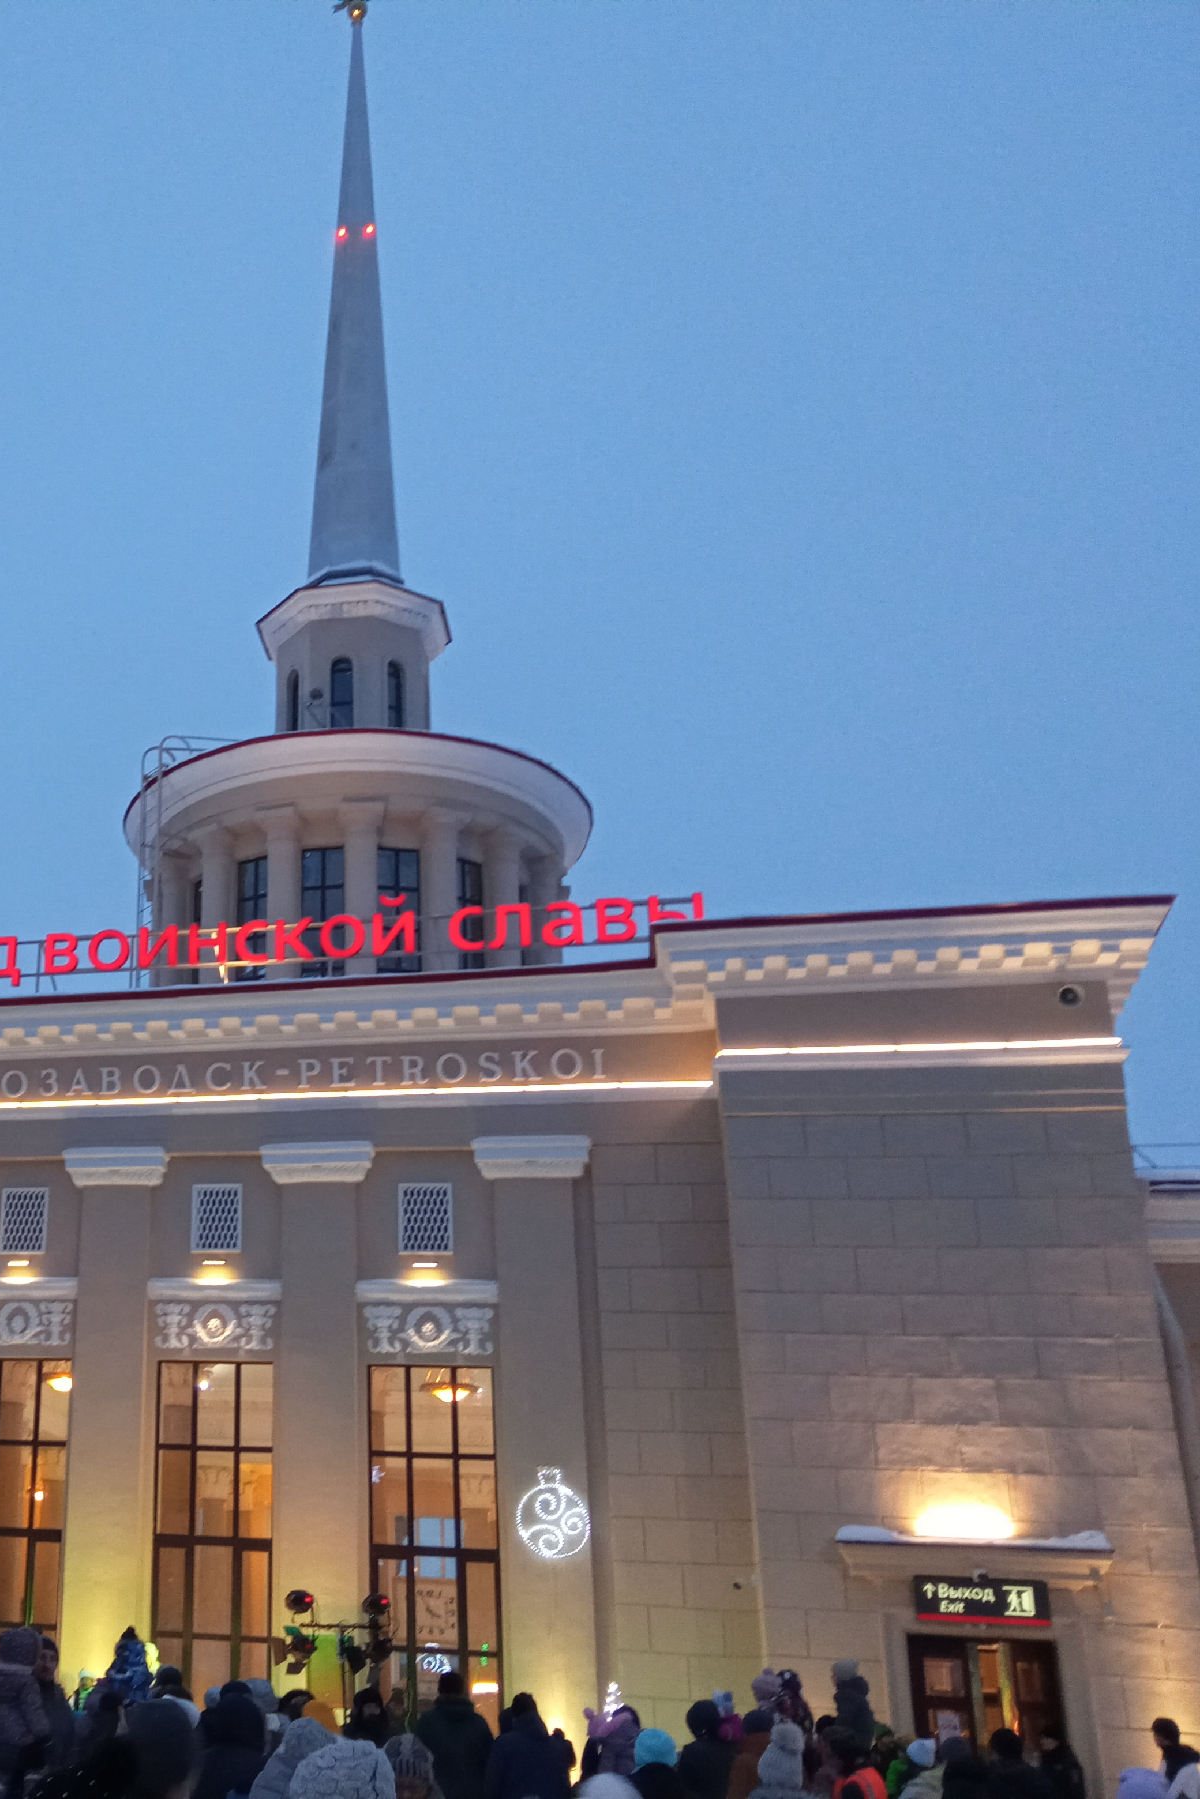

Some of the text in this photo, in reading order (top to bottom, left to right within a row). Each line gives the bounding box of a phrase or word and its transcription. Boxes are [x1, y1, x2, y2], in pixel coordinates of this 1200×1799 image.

[45, 894, 415, 974] воинской
[448, 893, 705, 951] славы
[937, 1582, 996, 1603] Выход
[939, 1600, 966, 1614] Exit
